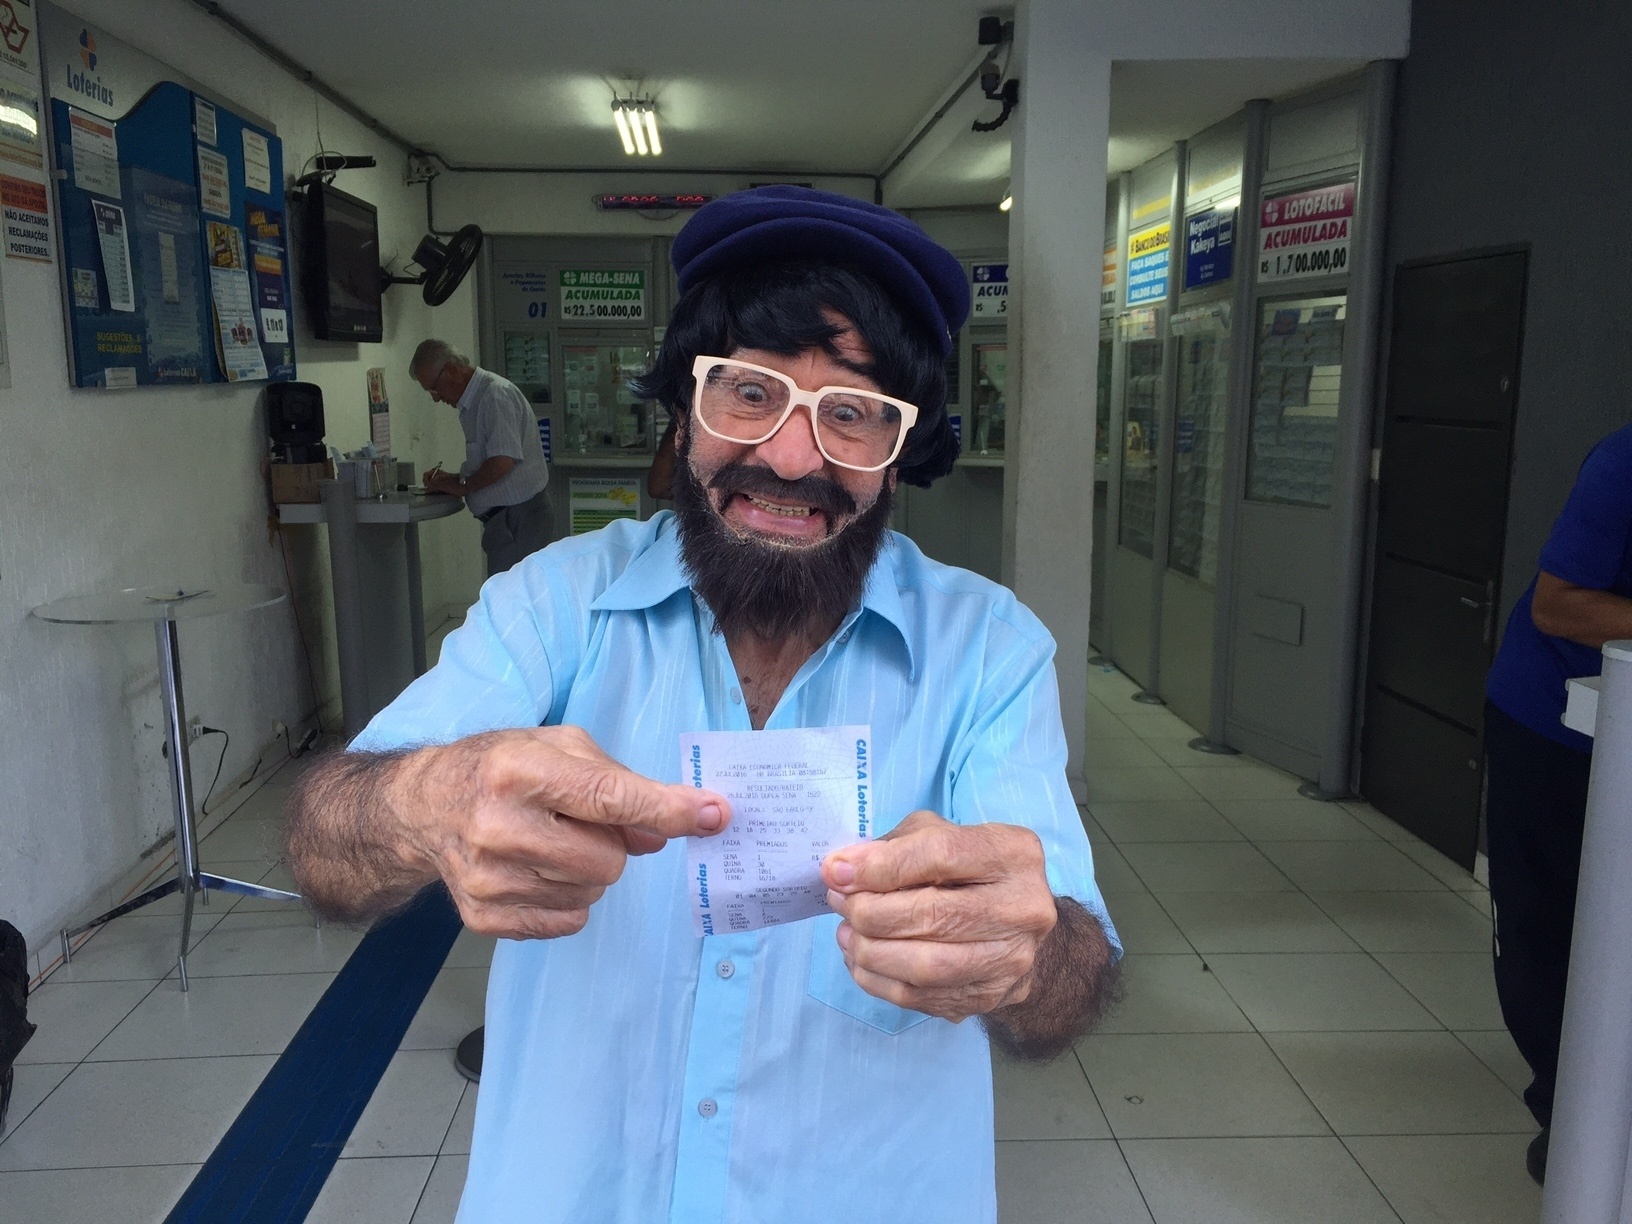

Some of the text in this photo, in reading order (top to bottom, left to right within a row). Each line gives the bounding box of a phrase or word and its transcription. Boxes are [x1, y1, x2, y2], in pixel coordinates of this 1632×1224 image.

[66, 63, 114, 107] Loterias
[4, 209, 49, 227] NÃO ACEITAMOS
[8, 226, 48, 242] RECLAMAÇÕES
[1264, 220, 1348, 250] ACUMULADA
[10, 242, 50, 257] POSTERIORES.
[579, 272, 640, 285] MEGA-SENA
[565, 290, 641, 301] ACUMULADA
[528, 301, 547, 318] 01
[573, 304, 642, 319] 22.500.000,00
[96, 331, 132, 343] SUGESTÕES
[690, 744, 702, 788] oterias
[856, 739, 870, 838] CAIXA Loterias
[696, 862, 710, 908] Loterias
